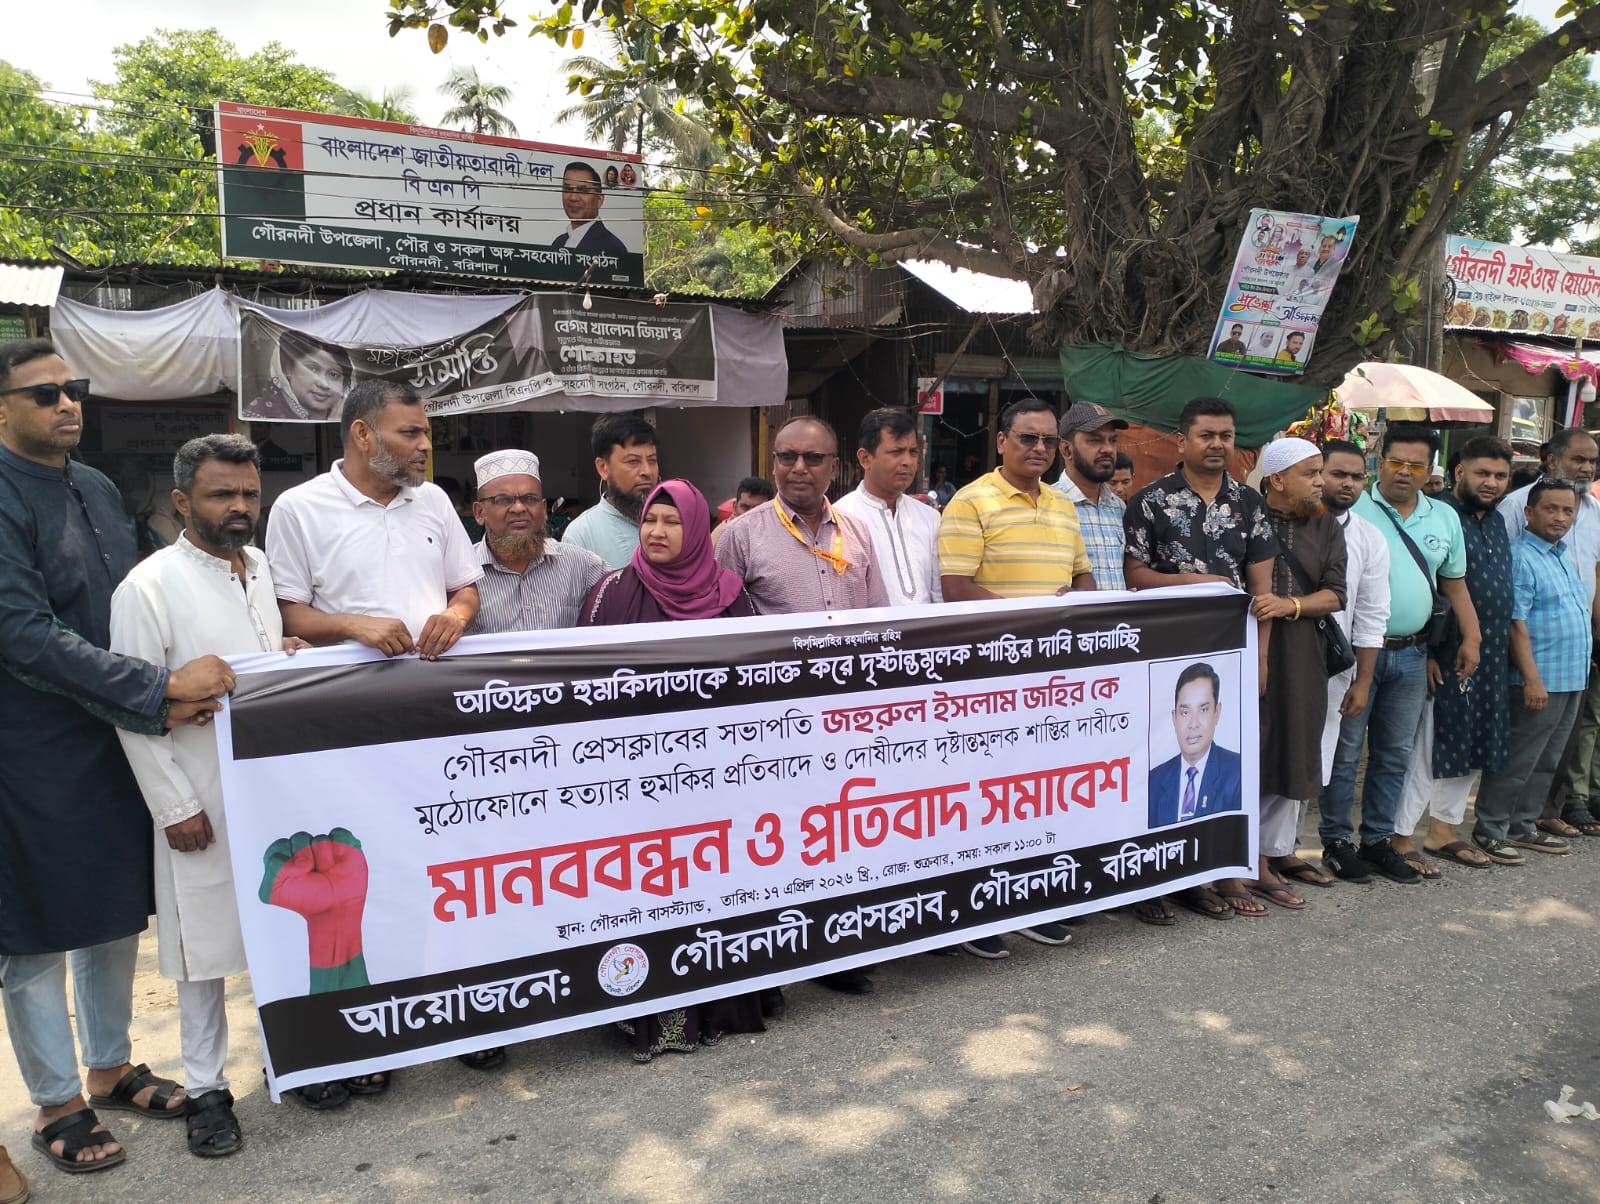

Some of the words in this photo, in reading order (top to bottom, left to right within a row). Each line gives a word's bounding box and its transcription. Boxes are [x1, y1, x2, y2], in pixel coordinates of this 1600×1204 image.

[318, 136, 406, 164] বাংলাদেশ
[411, 144, 522, 179] জাতীয়তাবাদী
[528, 161, 554, 182] দল
[401, 169, 421, 194] বি
[428, 178, 454, 198] এন
[463, 176, 481, 200] পি
[355, 200, 423, 225] প্রধান
[429, 206, 521, 234] কার্যালয়
[252, 222, 316, 245] গৌরনদী
[396, 234, 429, 254] পৌর
[434, 242, 446, 254] ও
[450, 243, 485, 260] সকল
[490, 245, 572, 266] অঙ্গ-সহযোগী
[1507, 256, 1560, 293] হাইওয়ে
[555, 319, 588, 335] বেগম
[591, 323, 635, 338] খালেদা
[637, 322, 682, 341] জিয়া'র
[423, 394, 461, 413] গৌরনদী
[462, 387, 503, 405] উপজেলা
[505, 379, 541, 399] বিএনপি
[671, 382, 700, 394] বরিশাল
[881, 629, 902, 641] রহিম
[453, 679, 565, 714] অতিদ্রুত
[571, 668, 729, 706] হুমকিদাতাকে
[736, 659, 802, 688] সনাক্ত
[808, 654, 854, 685] করে
[859, 644, 972, 686] দৃষ্টান্তমূলক
[977, 633, 1033, 665] শাস্তির
[1038, 629, 1073, 658] দাবি
[1076, 622, 1141, 654] জানাচ্ছি
[443, 735, 561, 781] গৌরনদী
[572, 726, 709, 765] প্রেসক্লাবের
[717, 708, 813, 746] সভাপতি
[822, 698, 927, 735] জহুরুল
[932, 687, 1018, 722] ইসলাম
[1022, 675, 1086, 708] জহির
[1090, 676, 1120, 702] কে
[415, 791, 549, 835] মুঠোফোনে
[556, 778, 631, 808] হত্যার
[639, 763, 716, 803] হুমকির
[723, 754, 813, 786] প্রতিবাদে
[821, 753, 837, 771] ও
[845, 736, 927, 771] দোষীদের
[935, 725, 1020, 765] দৃষ্টান্তমূলক
[1025, 715, 1069, 745] শাস্তির
[1076, 708, 1130, 737] দাবীতে
[426, 818, 732, 922] মানববন্ধন
[746, 812, 785, 867] ও
[800, 777, 970, 866] প্রতিবাদ
[979, 756, 1130, 826] সমাবেশ
[556, 922, 585, 941] স্থান:
[590, 908, 642, 933] গৌরনদী
[646, 899, 712, 922] বাসস্ট্যান্ড,
[720, 889, 760, 908] তারিখ:
[764, 887, 779, 901] ১৭
[783, 877, 815, 896] এপ্রিল
[819, 874, 853, 891] ২০২৬
[882, 861, 910, 878] রোজ:
[913, 852, 954, 871] শুক্রবার,
[957, 847, 982, 863] সময়:
[984, 840, 1012, 857] সকাল
[1013, 837, 1042, 852] ১১:০০
[1045, 831, 1057, 845] টা
[339, 968, 572, 1038] আয়োজনে:
[670, 908, 814, 977] গৌরনদী
[824, 889, 961, 945] প্রেসক্লাব,
[970, 856, 1093, 911] গৌরনদী,
